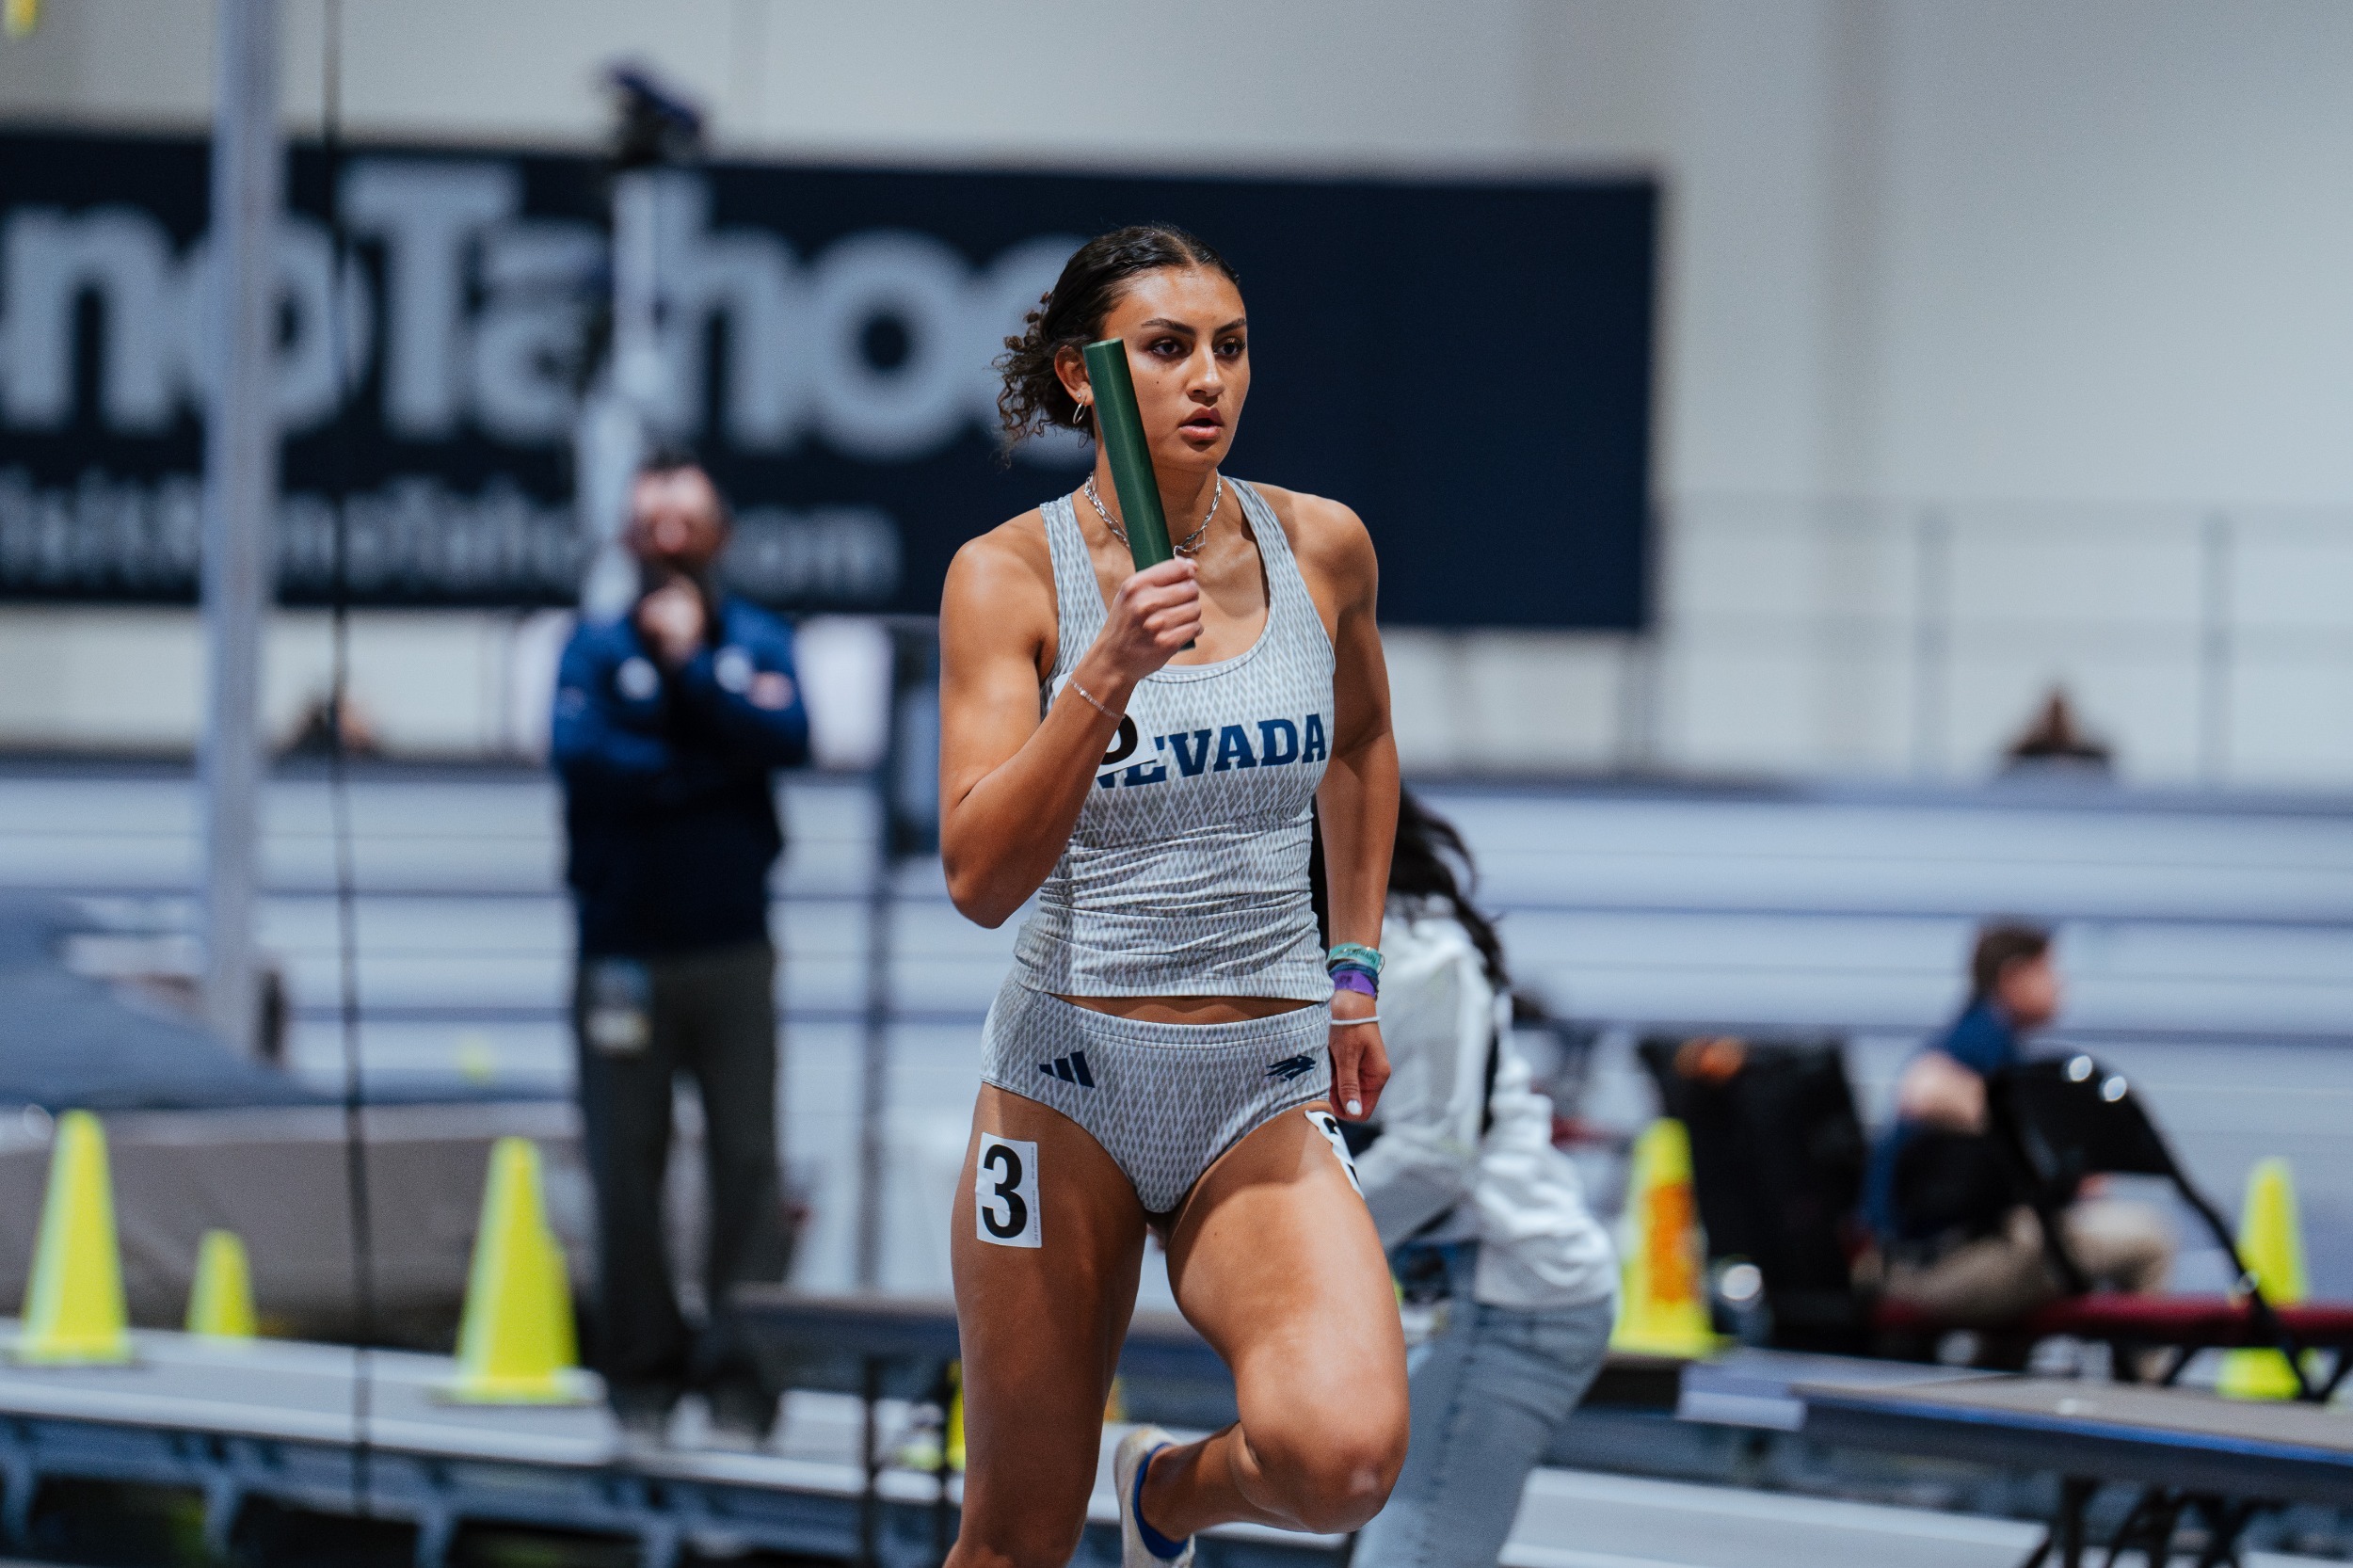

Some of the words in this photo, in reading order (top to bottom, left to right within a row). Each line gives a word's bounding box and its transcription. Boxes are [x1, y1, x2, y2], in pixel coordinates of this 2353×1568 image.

[0, 162, 1099, 467] noTaho
[1096, 712, 1327, 789] EVADA
[982, 1144, 1028, 1239] 3
